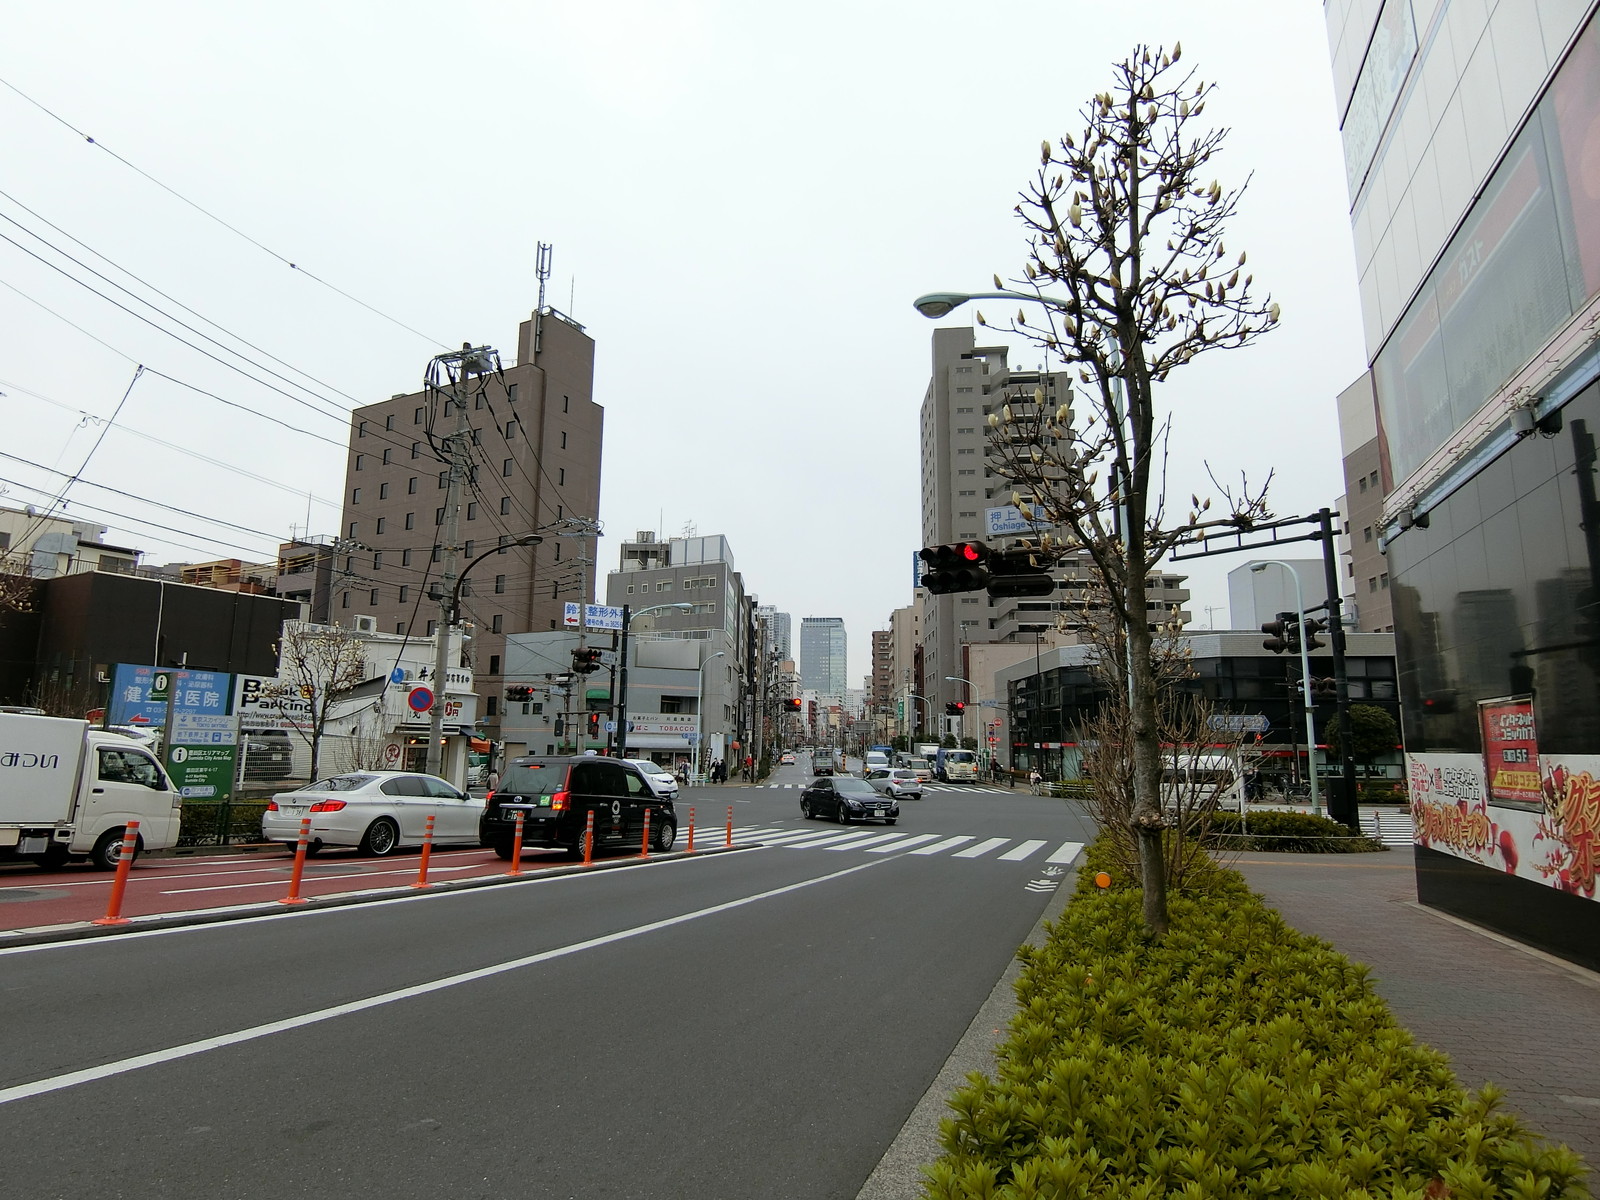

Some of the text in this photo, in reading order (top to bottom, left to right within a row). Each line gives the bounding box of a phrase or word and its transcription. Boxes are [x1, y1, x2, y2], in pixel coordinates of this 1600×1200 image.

[1457, 240, 1484, 285] ガスト
[990, 505, 1045, 522] 押上前
[992, 521, 1026, 531] Oshiage
[243, 679, 299, 696] Brak
[241, 693, 313, 713] Parking
[1500, 773, 1539, 787] 入口はコチラ
[1564, 771, 1600, 834] グラ
